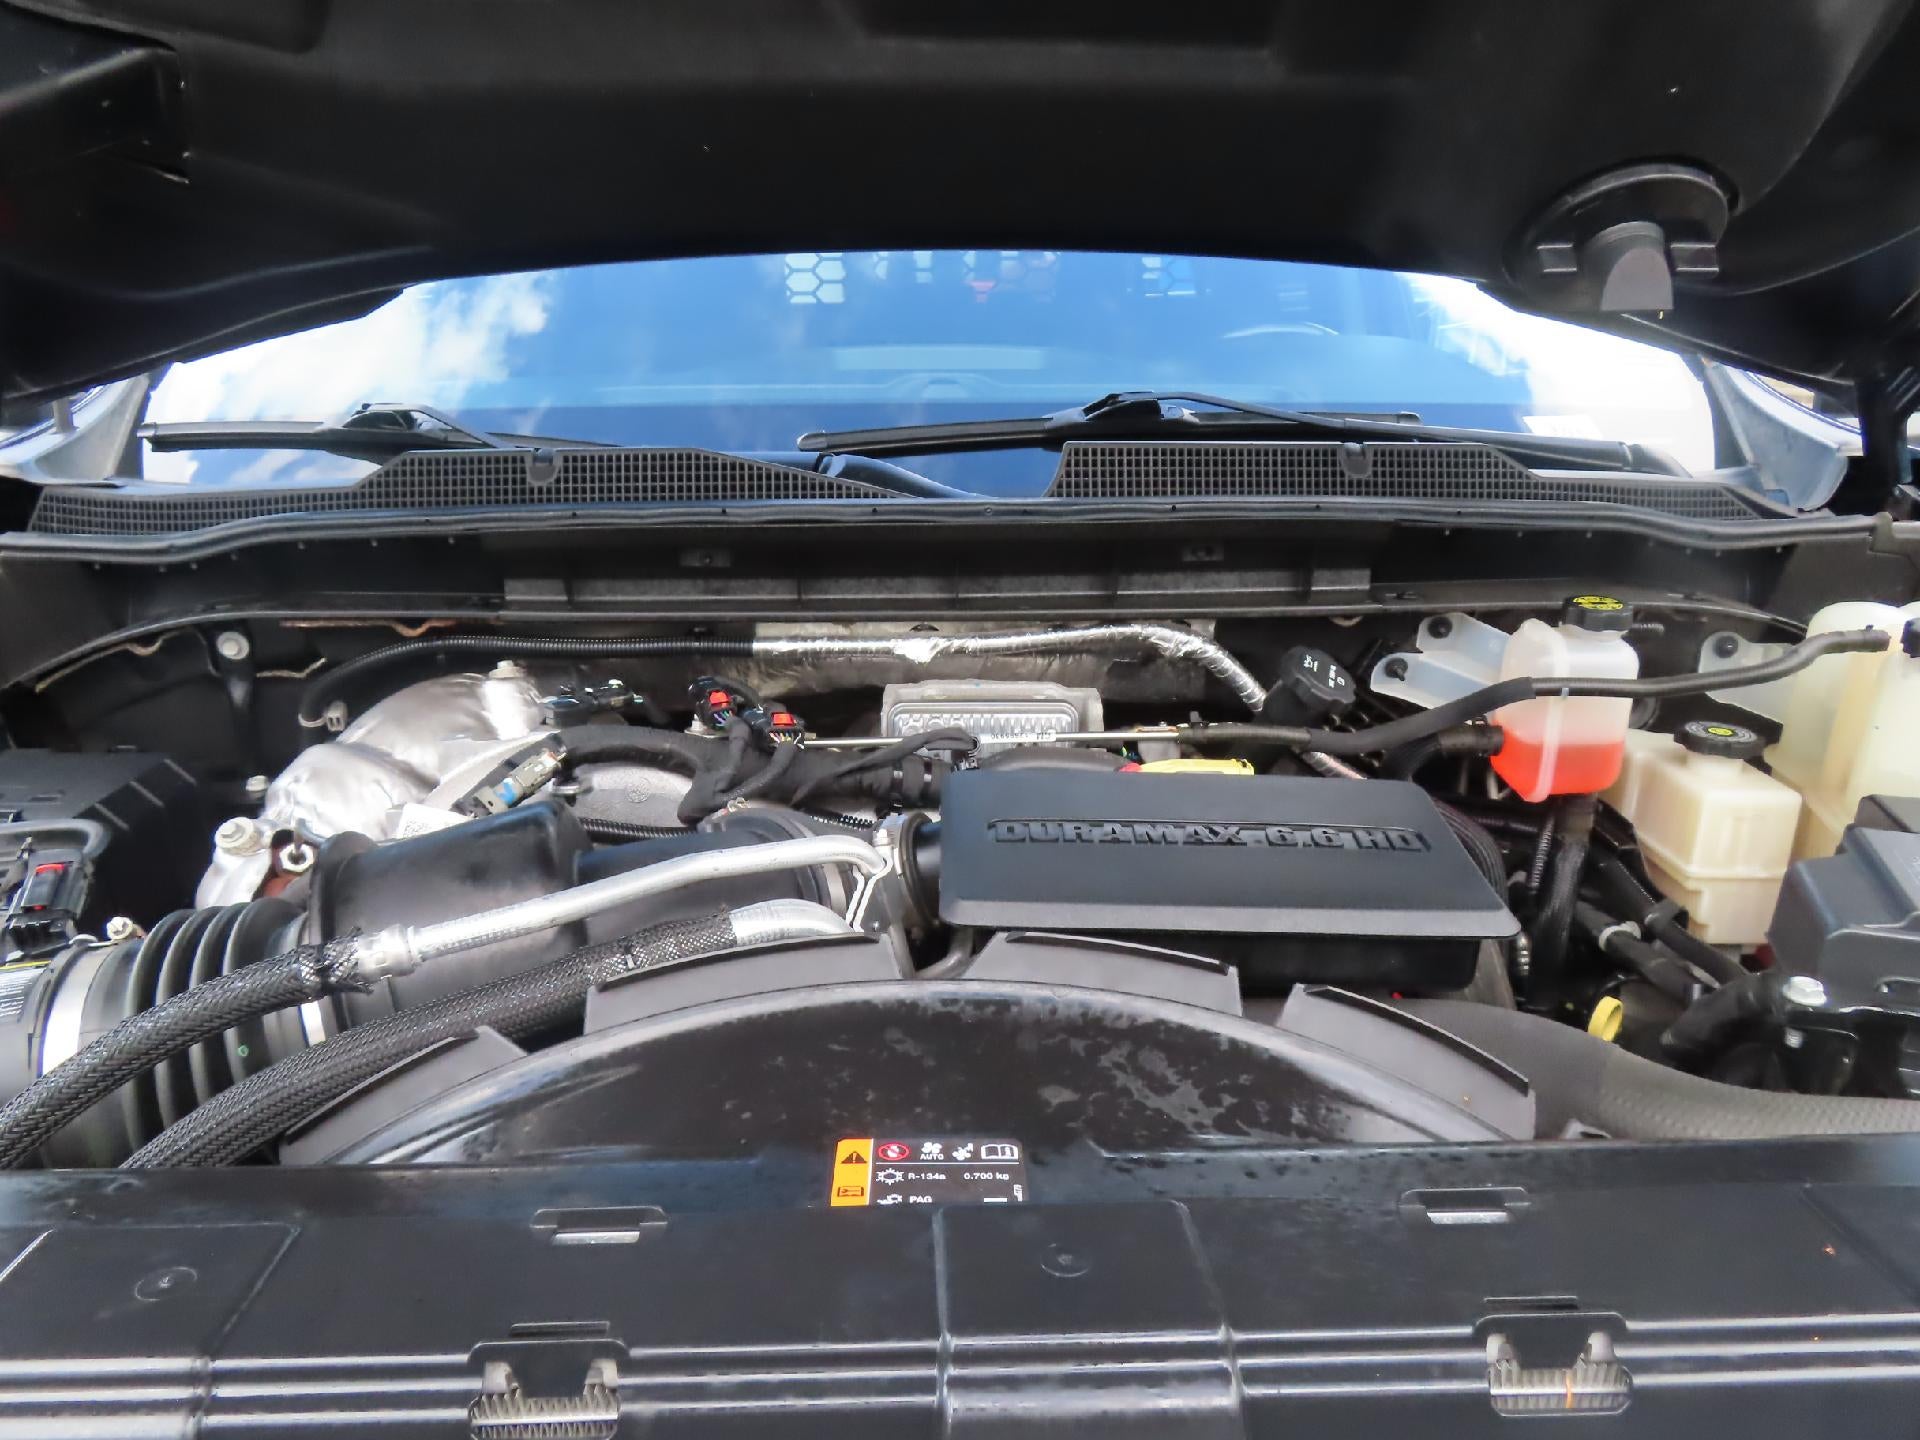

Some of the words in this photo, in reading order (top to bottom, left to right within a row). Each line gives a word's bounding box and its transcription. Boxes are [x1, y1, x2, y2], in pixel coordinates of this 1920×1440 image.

[994, 822, 1247, 846] DURAMAX
[1265, 826, 1345, 848] 6.6
[1352, 830, 1423, 852] HD
[908, 1172, 946, 1180] R-134a
[963, 1172, 993, 1180] 0.700
[996, 1172, 1010, 1181] kg
[909, 1195, 933, 1203] PAG
